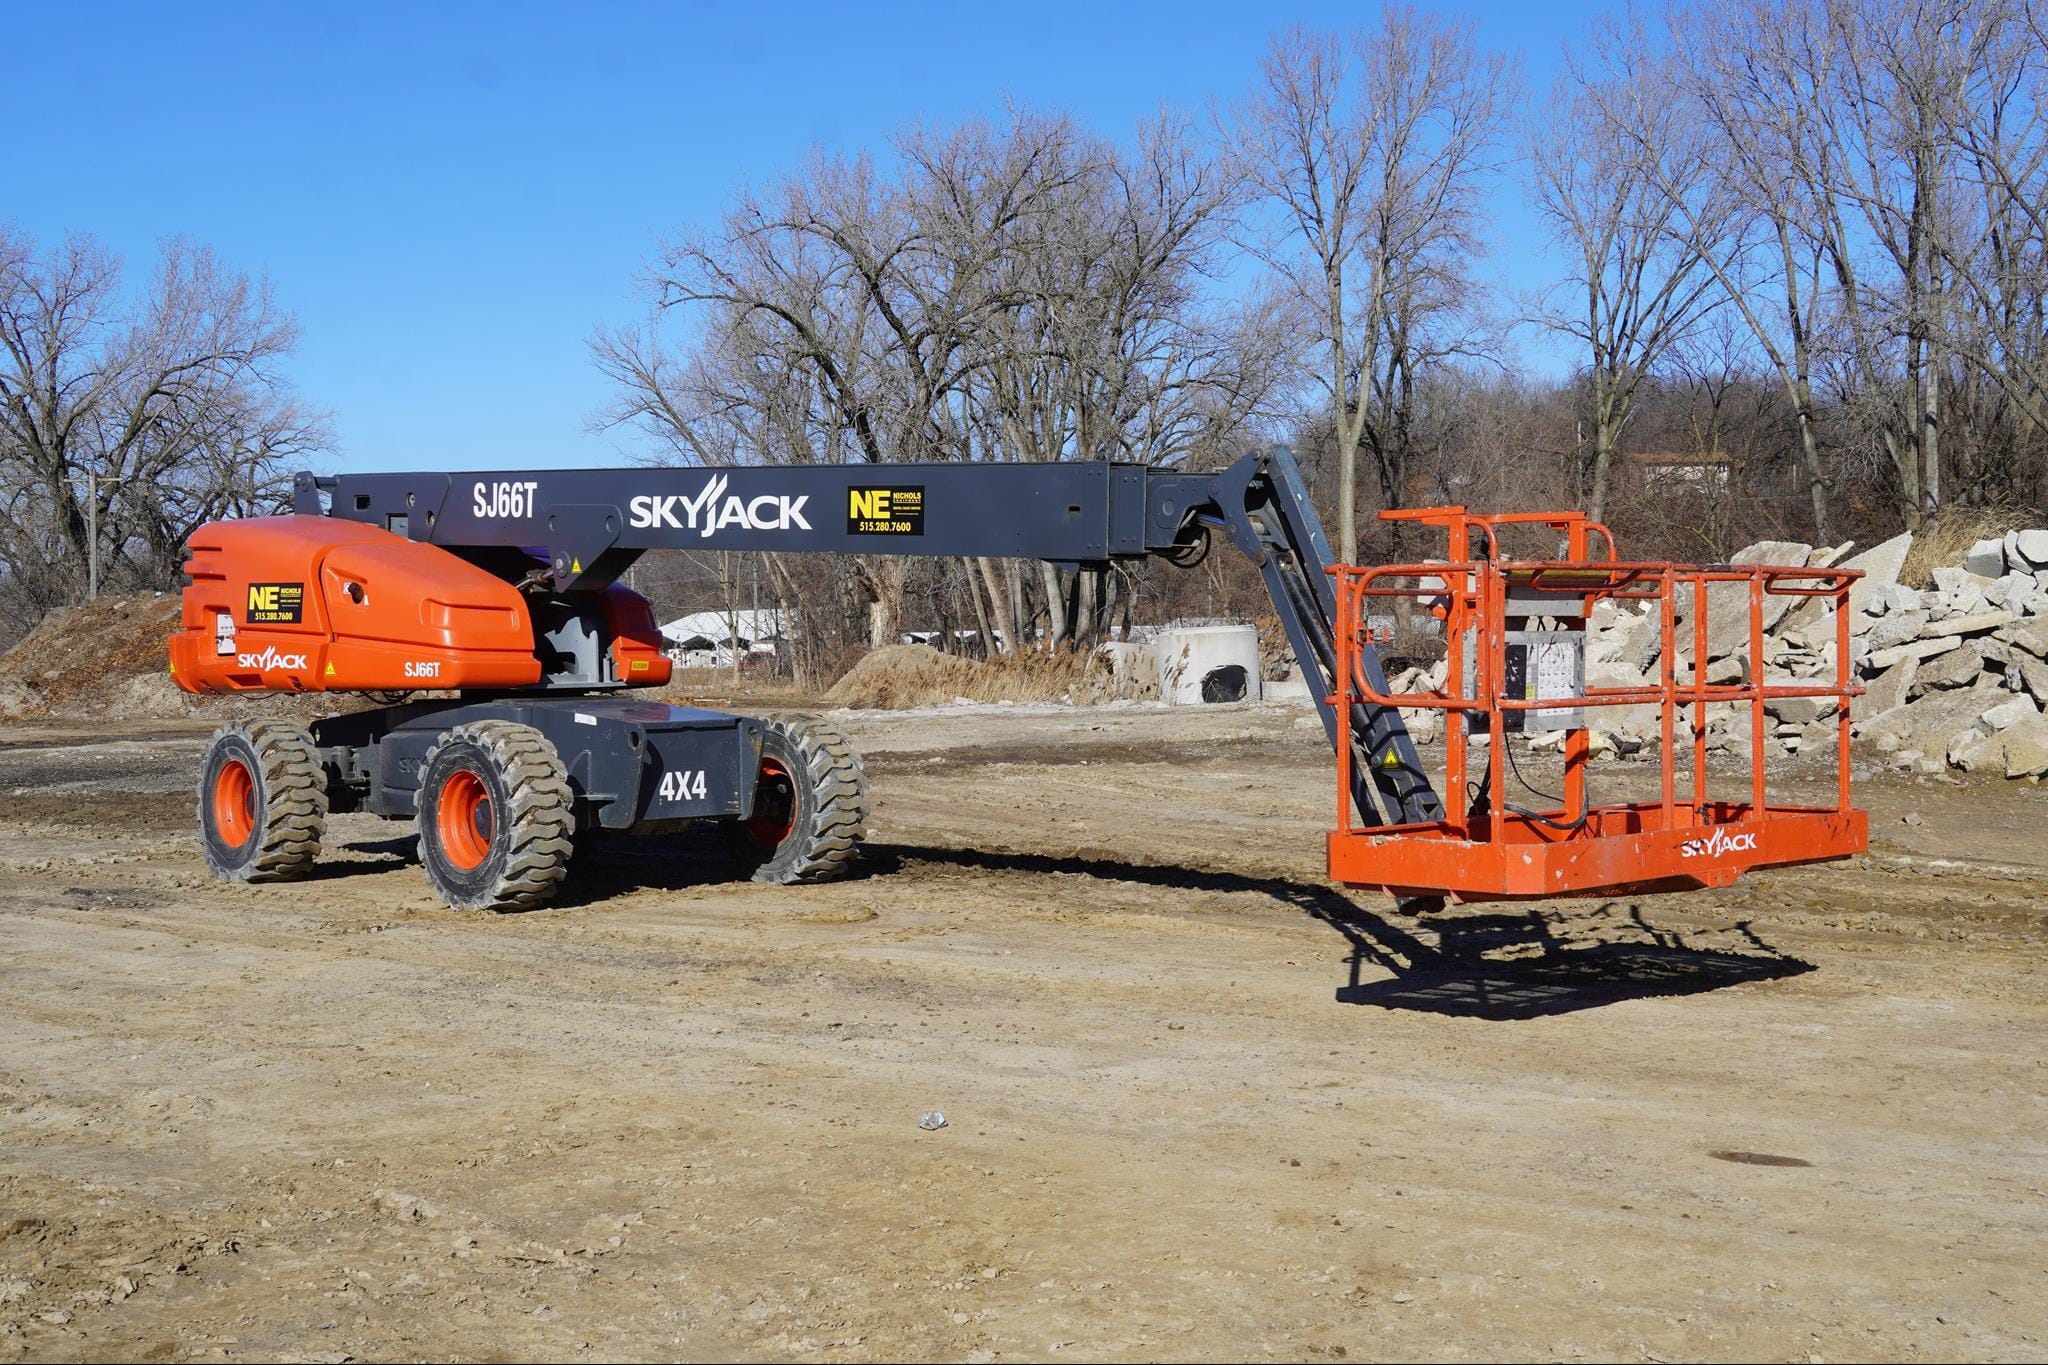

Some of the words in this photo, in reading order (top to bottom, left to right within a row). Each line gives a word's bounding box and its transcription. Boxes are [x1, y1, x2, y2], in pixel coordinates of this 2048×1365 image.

[472, 481, 538, 519] SJ66T
[629, 473, 813, 538] SKYJACK
[850, 490, 891, 519] NE
[859, 522, 911, 531] 515.280.7600
[249, 586, 280, 610] NE
[255, 612, 293, 621] 515.280.7600
[237, 645, 308, 672] SKYJACK
[404, 661, 442, 678] SJ66T
[659, 770, 707, 802] 4X4
[1681, 827, 1757, 858] SKYJACK
